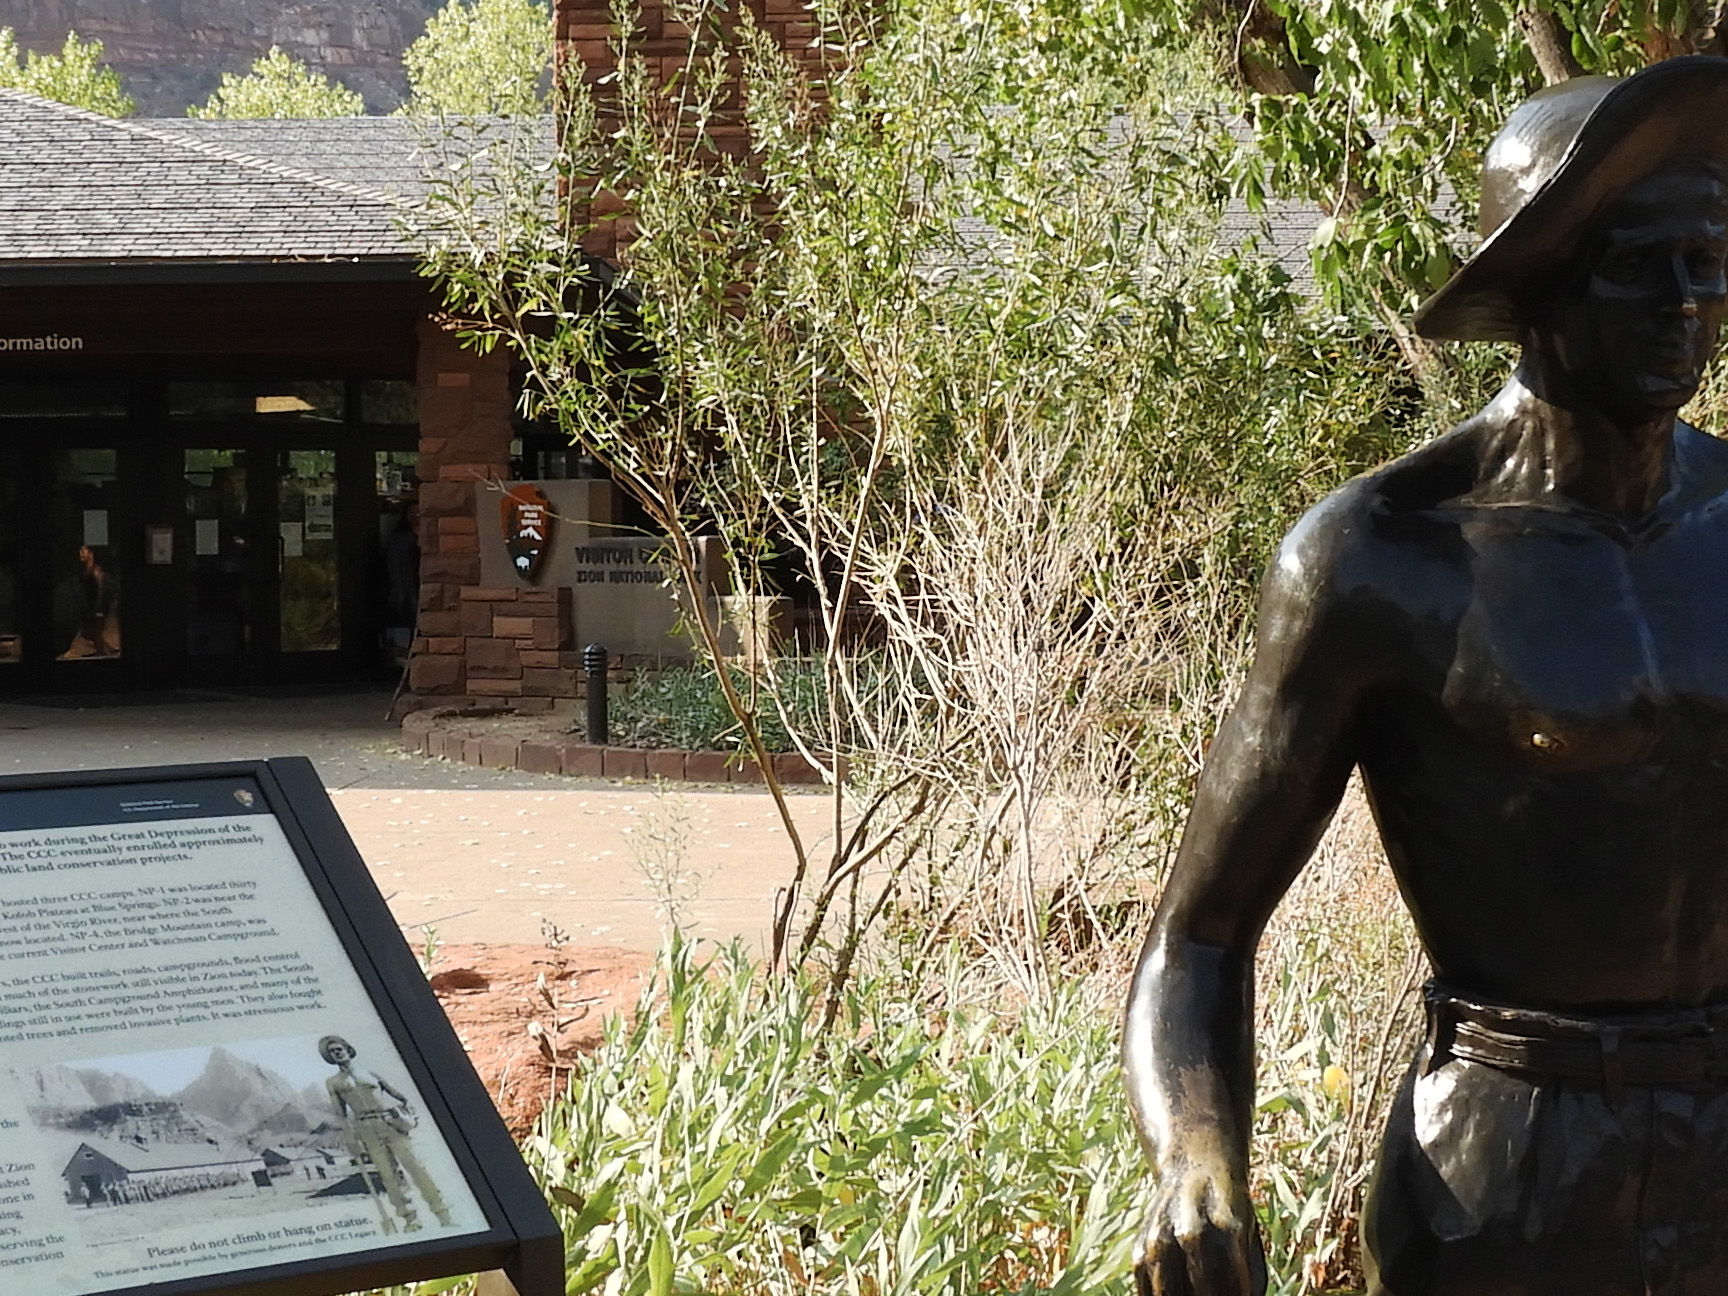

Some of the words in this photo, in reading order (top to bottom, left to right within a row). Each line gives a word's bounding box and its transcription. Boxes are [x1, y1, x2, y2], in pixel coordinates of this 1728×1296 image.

[8, 838, 42, 849] work
[41, 836, 88, 846] during
[86, 833, 109, 843] the
[108, 831, 146, 841] Great
[146, 827, 216, 840] Depression
[217, 824, 231, 834] of
[231, 823, 252, 833] the
[25, 849, 58, 860] CCC
[59, 845, 125, 857] eventually
[125, 840, 178, 853] enrolled
[178, 834, 266, 851] approximately
[23, 862, 55, 873] land
[56, 857, 138, 870] conservation
[139, 853, 193, 866] projects.
[145, 1245, 188, 1258] Please
[187, 1240, 206, 1252] do
[207, 1237, 230, 1249] not
[230, 1230, 266, 1245] climb
[267, 1231, 282, 1240] or
[282, 1226, 316, 1237] hang
[315, 1223, 332, 1233] on
[333, 1218, 373, 1230] statue.
